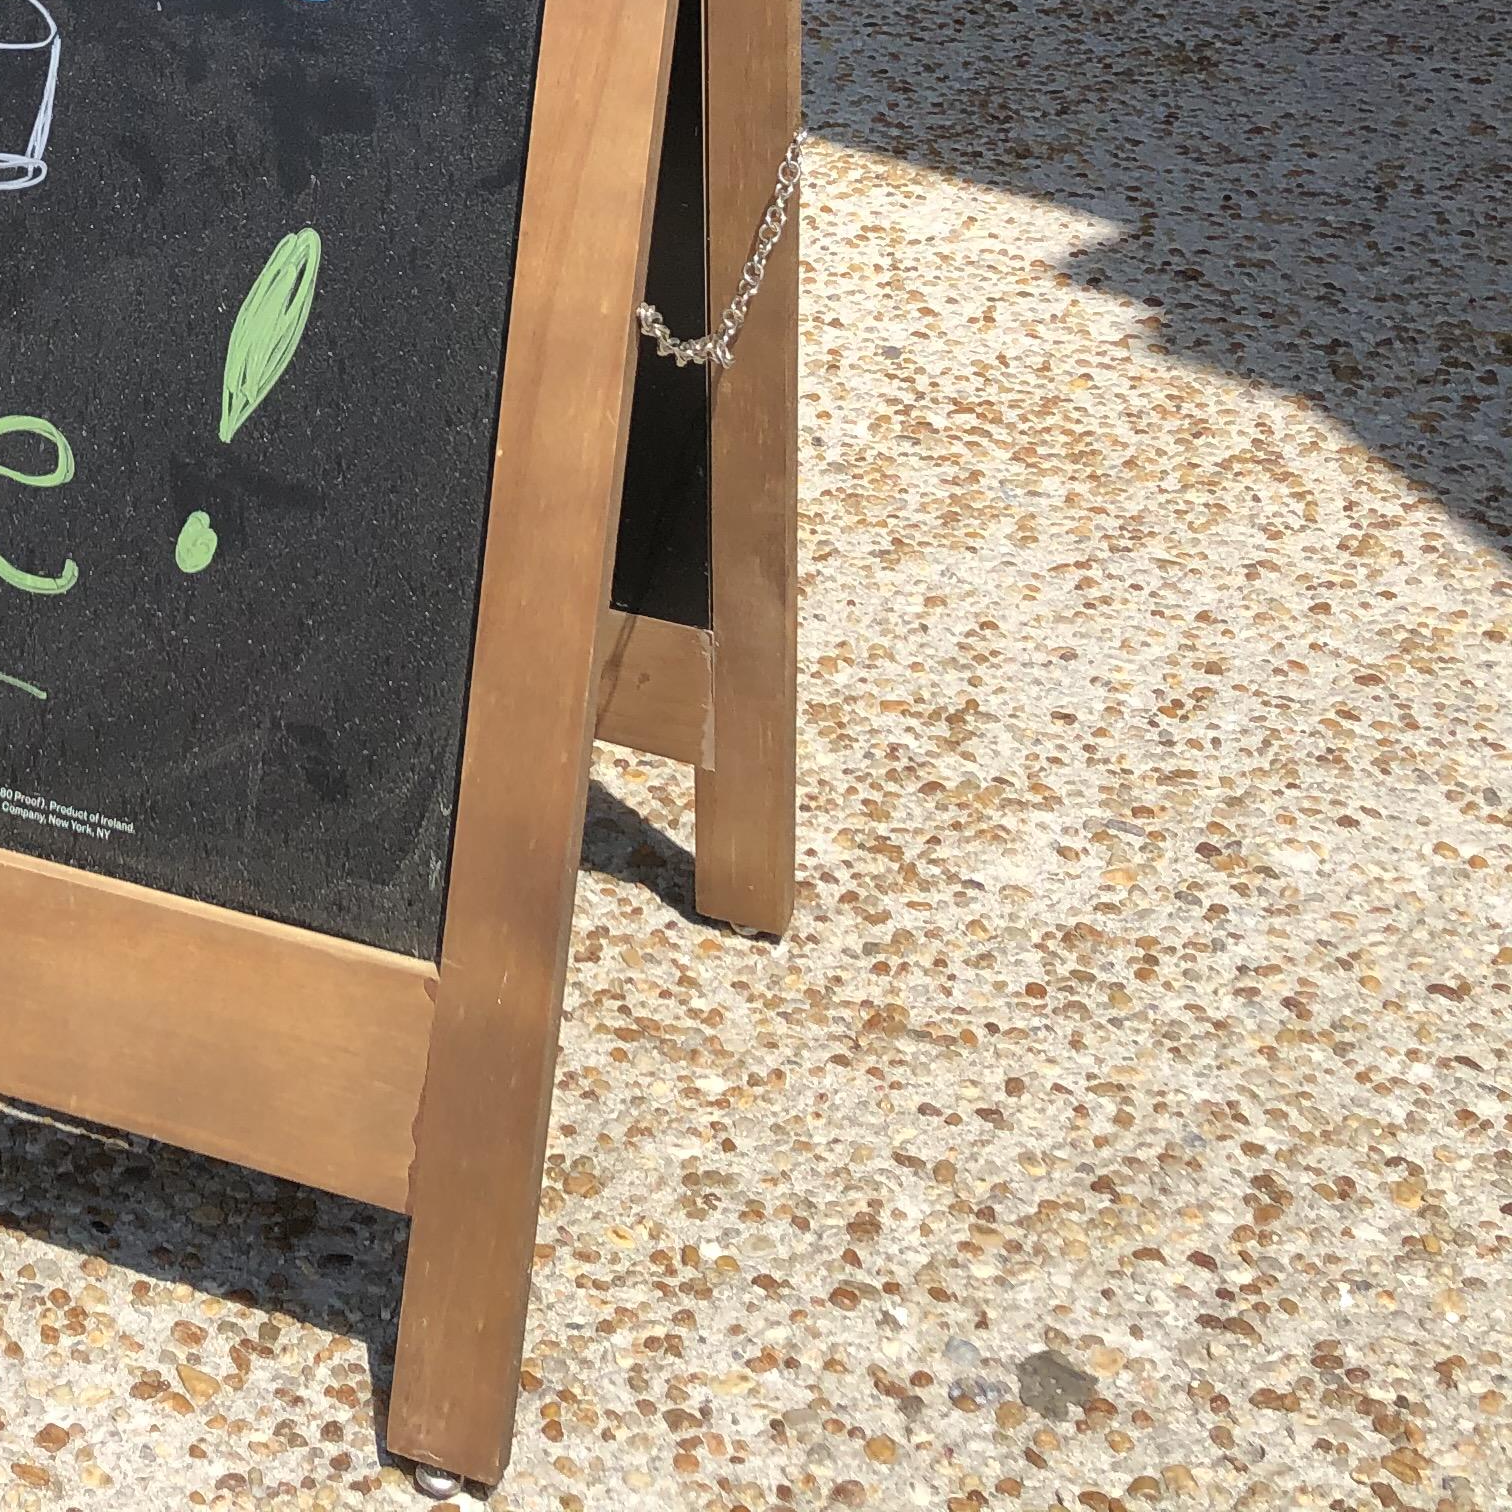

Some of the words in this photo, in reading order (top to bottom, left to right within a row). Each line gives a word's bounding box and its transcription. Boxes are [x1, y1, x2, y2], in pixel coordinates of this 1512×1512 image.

[49, 800, 88, 821] Product
[89, 811, 100, 824] of
[48, 813, 70, 829] New
[96, 827, 111, 840] NY
